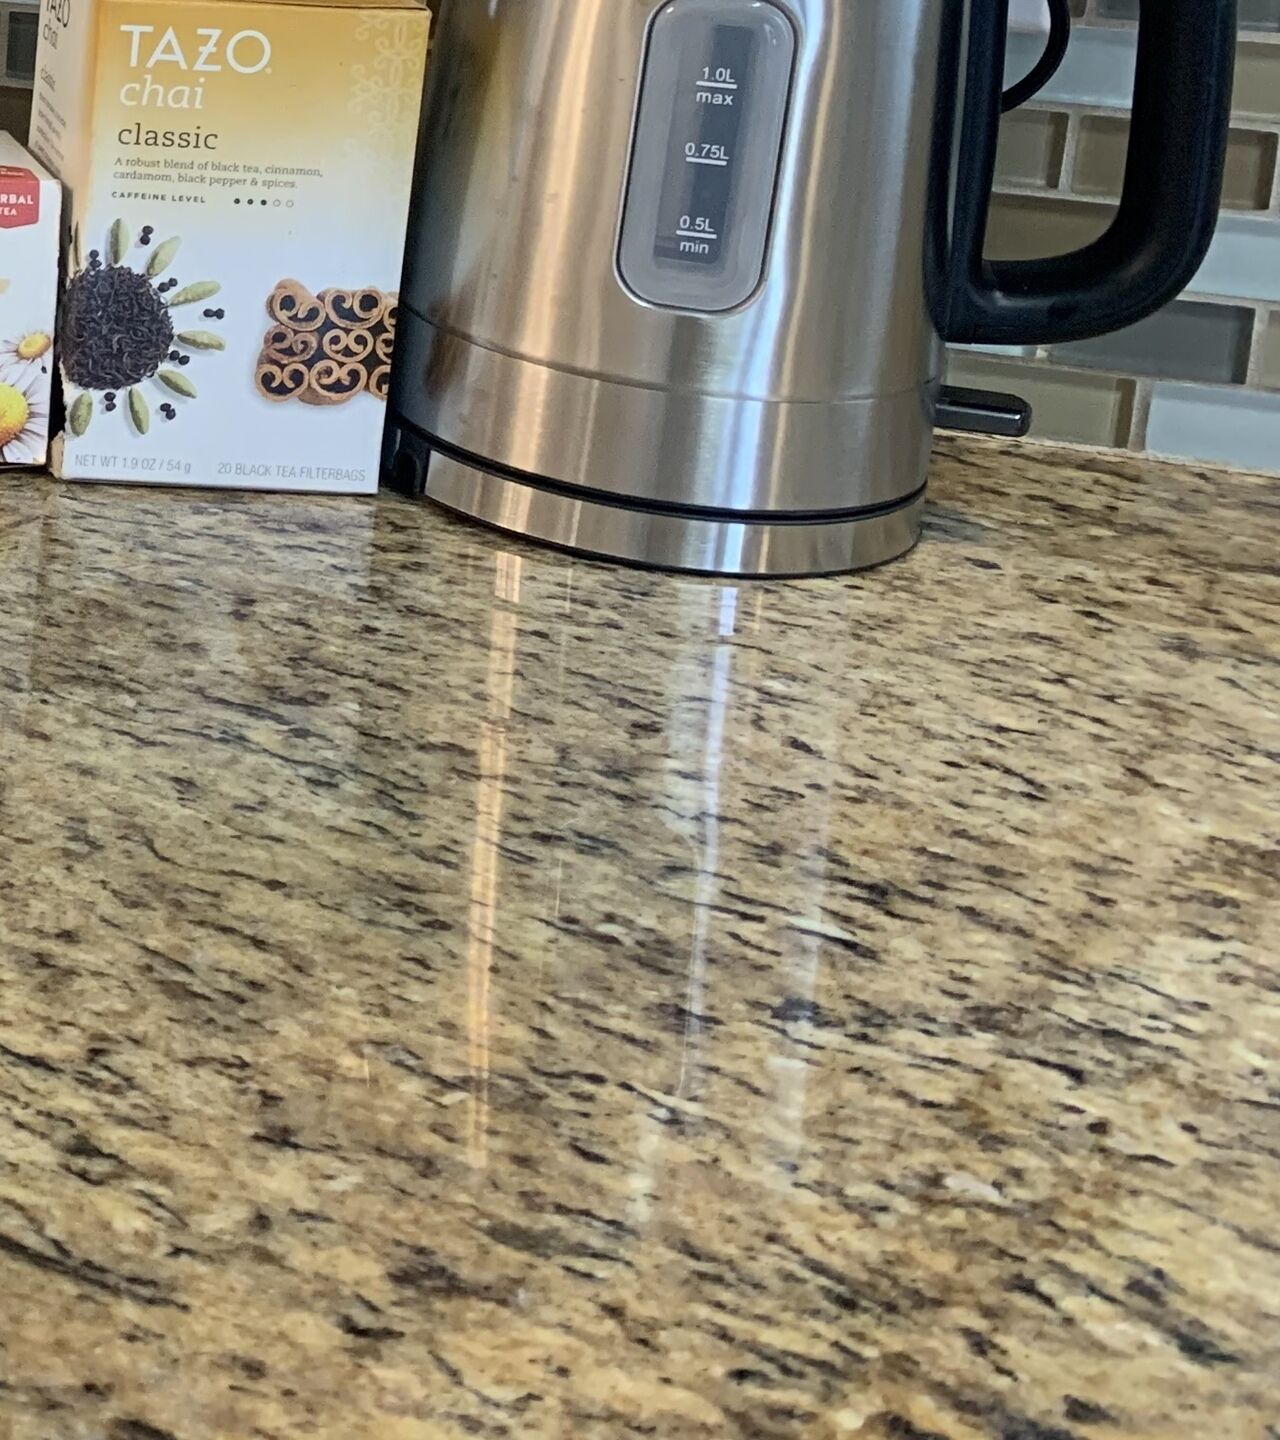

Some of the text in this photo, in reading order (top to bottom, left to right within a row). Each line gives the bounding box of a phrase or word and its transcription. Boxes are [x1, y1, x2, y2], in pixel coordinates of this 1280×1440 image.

[120, 24, 271, 74] TAZO
[702, 67, 736, 83] 1.0L
[119, 74, 205, 109] chai
[696, 91, 734, 106] max
[118, 122, 219, 150] classic
[684, 142, 730, 160] 0.75L
[114, 157, 323, 177] A robust blend of black tea, cinnamon,
[113, 170, 297, 190] cardamom, black pepper & spices.
[111, 191, 206, 203] CAFFEINE LEVEL
[679, 215, 715, 232] 0.5L
[679, 241, 710, 254] min
[75, 454, 97, 467] NET
[100, 456, 117, 468] WT
[122, 457, 138, 470] 1.9
[141, 458, 156, 470] OZ
[166, 459, 182, 472] 54
[184, 463, 192, 474] g
[217, 462, 366, 482] 20 BLACK TEA FILTERBAGS
